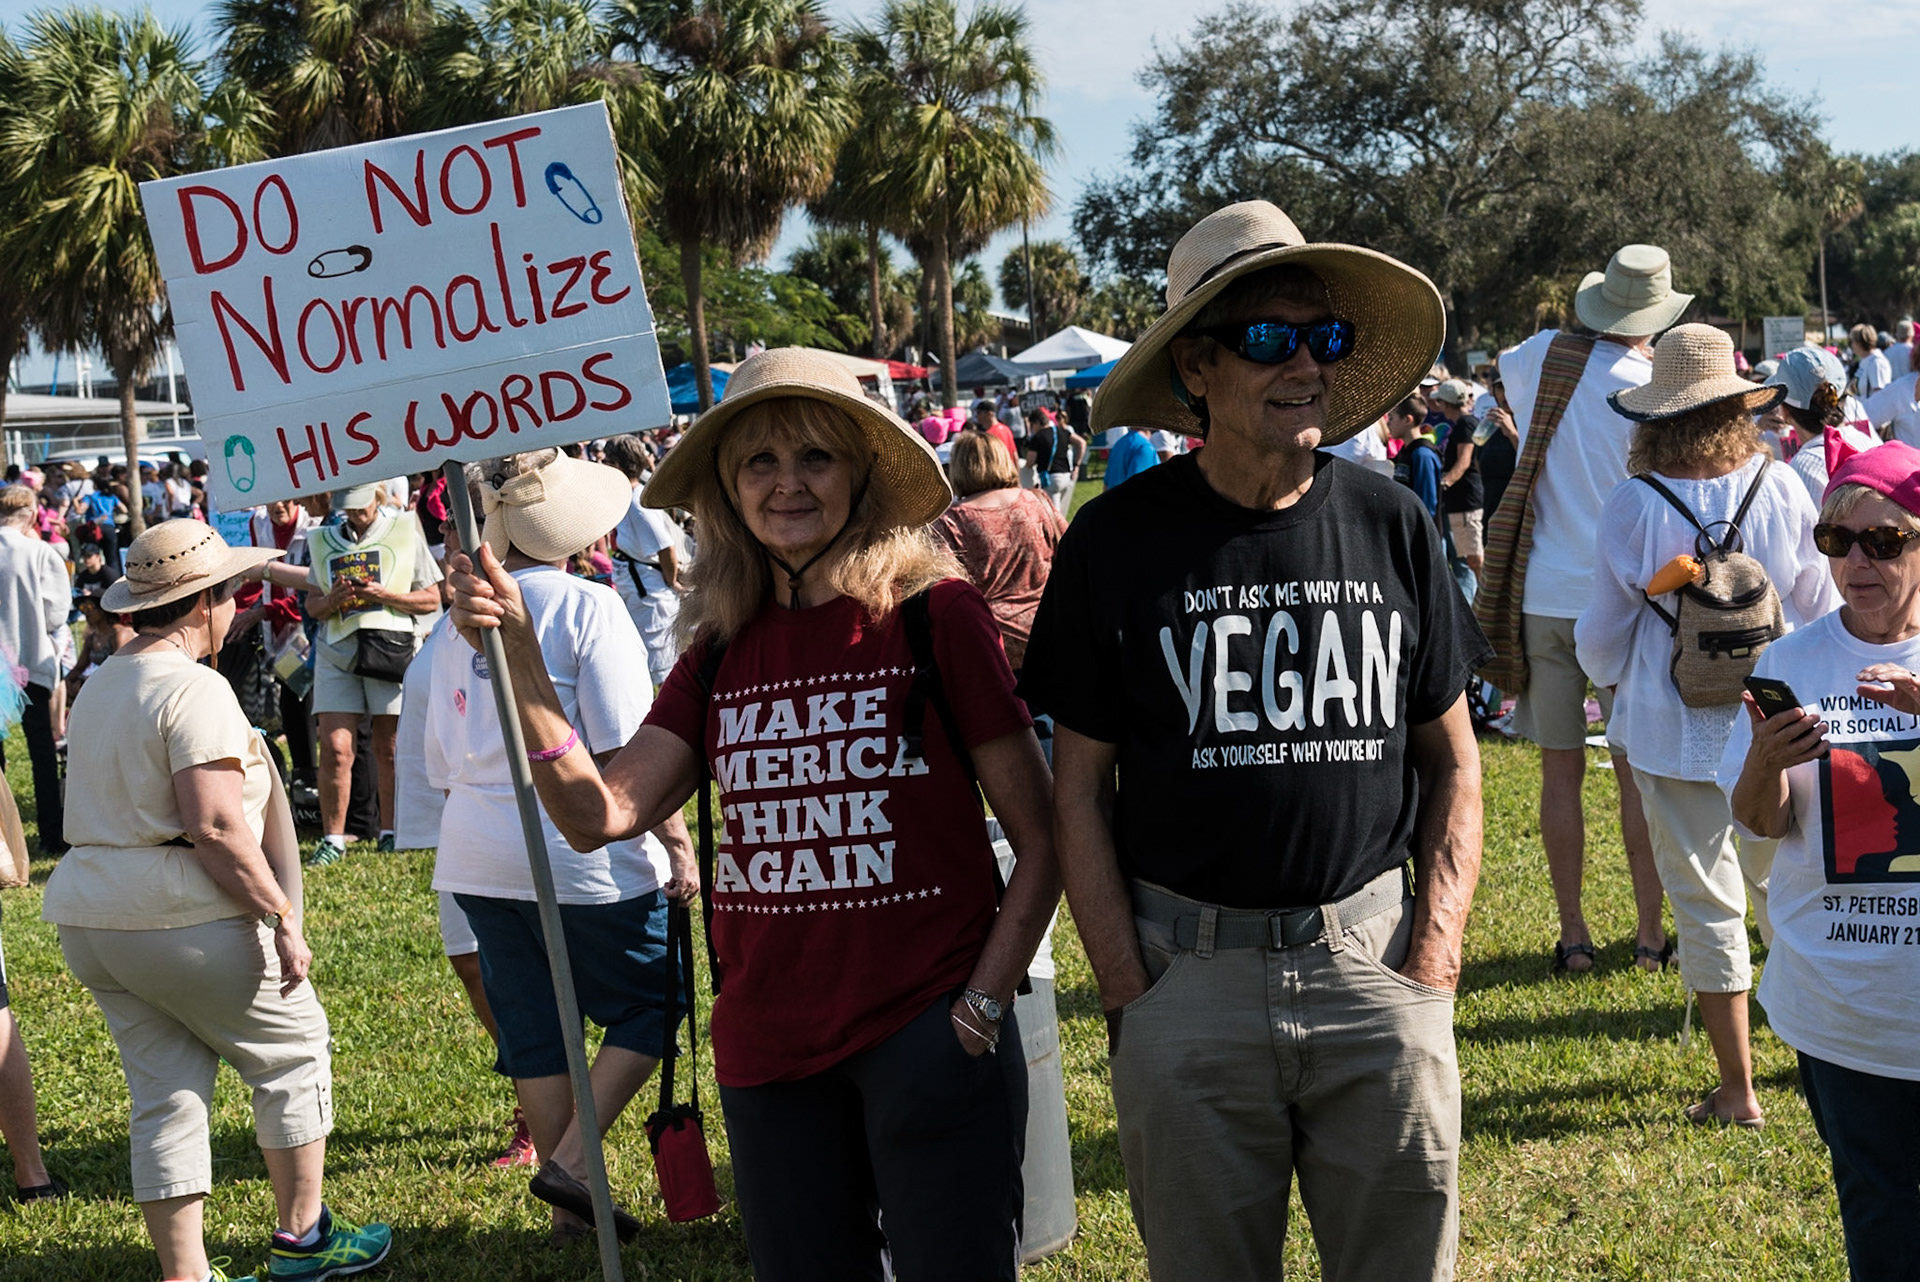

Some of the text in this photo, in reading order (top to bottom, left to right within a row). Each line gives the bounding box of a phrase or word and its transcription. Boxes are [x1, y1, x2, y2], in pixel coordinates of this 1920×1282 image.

[177, 127, 541, 274] DO NOT
[211, 222, 631, 392] Normalize
[276, 352, 632, 489] HIS WORDS
[1184, 580, 1384, 613] DON'T ASK ME WHY I'M A
[1159, 610, 1402, 736] VEGAN
[717, 687, 887, 748] MAKE
[1847, 716, 1906, 734] SOCIAL
[715, 736, 929, 795] MERICA
[1192, 739, 1385, 769] ASK YOURSELF WHY YOU'RE NOT
[722, 790, 892, 845] THINK
[715, 841, 896, 893] AGAIN
[1823, 896, 1920, 916] ST. PETERSB
[1826, 922, 1900, 945] JANUARY
